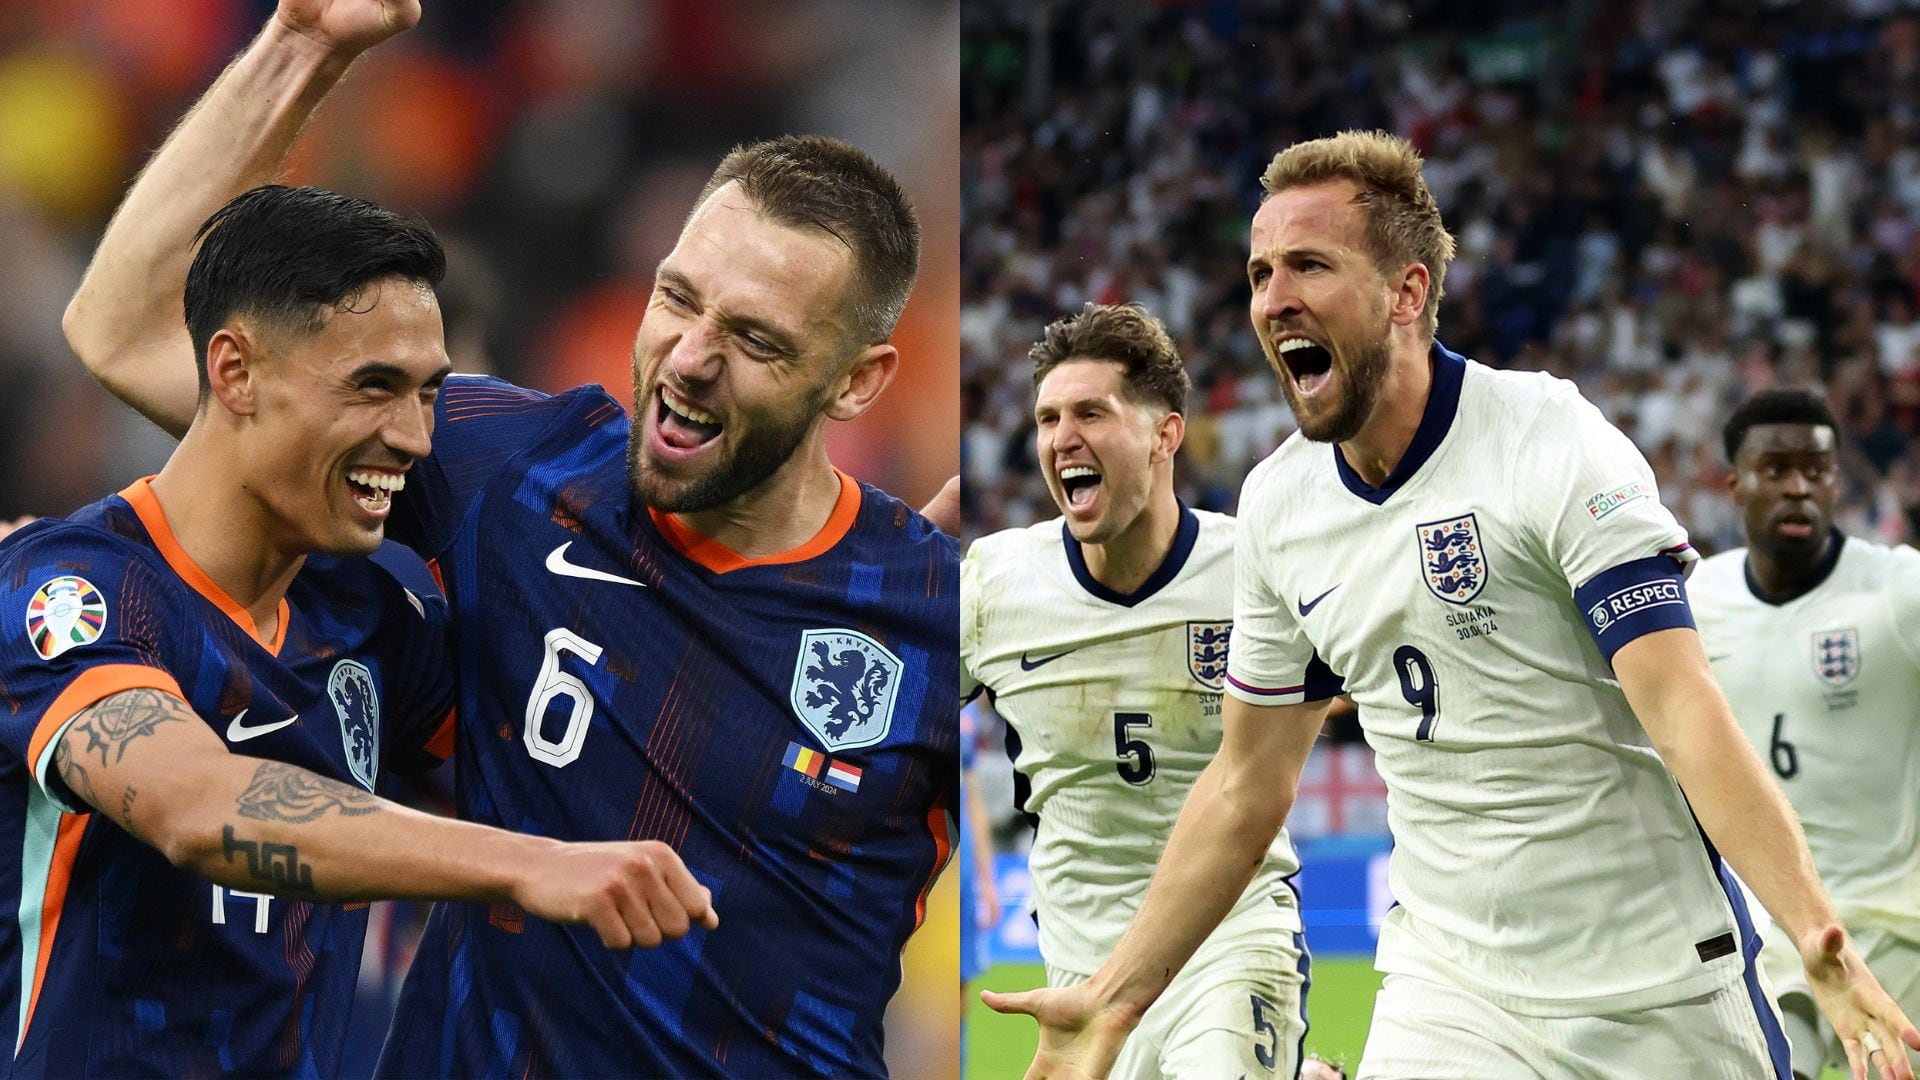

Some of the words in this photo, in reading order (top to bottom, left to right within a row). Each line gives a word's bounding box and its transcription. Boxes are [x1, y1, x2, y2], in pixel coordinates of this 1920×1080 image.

[1589, 484, 1649, 518] FOUNDAT
[1446, 606, 1496, 627] SLOVAKIA
[1610, 584, 1681, 615] RESPECT
[523, 627, 603, 769] 6
[1393, 645, 1440, 743] 9
[1114, 712, 1156, 786] 5
[1769, 713, 1799, 780] 6
[805, 777, 821, 789] JULY
[820, 784, 838, 796] 2024
[1249, 993, 1281, 1074] 5
